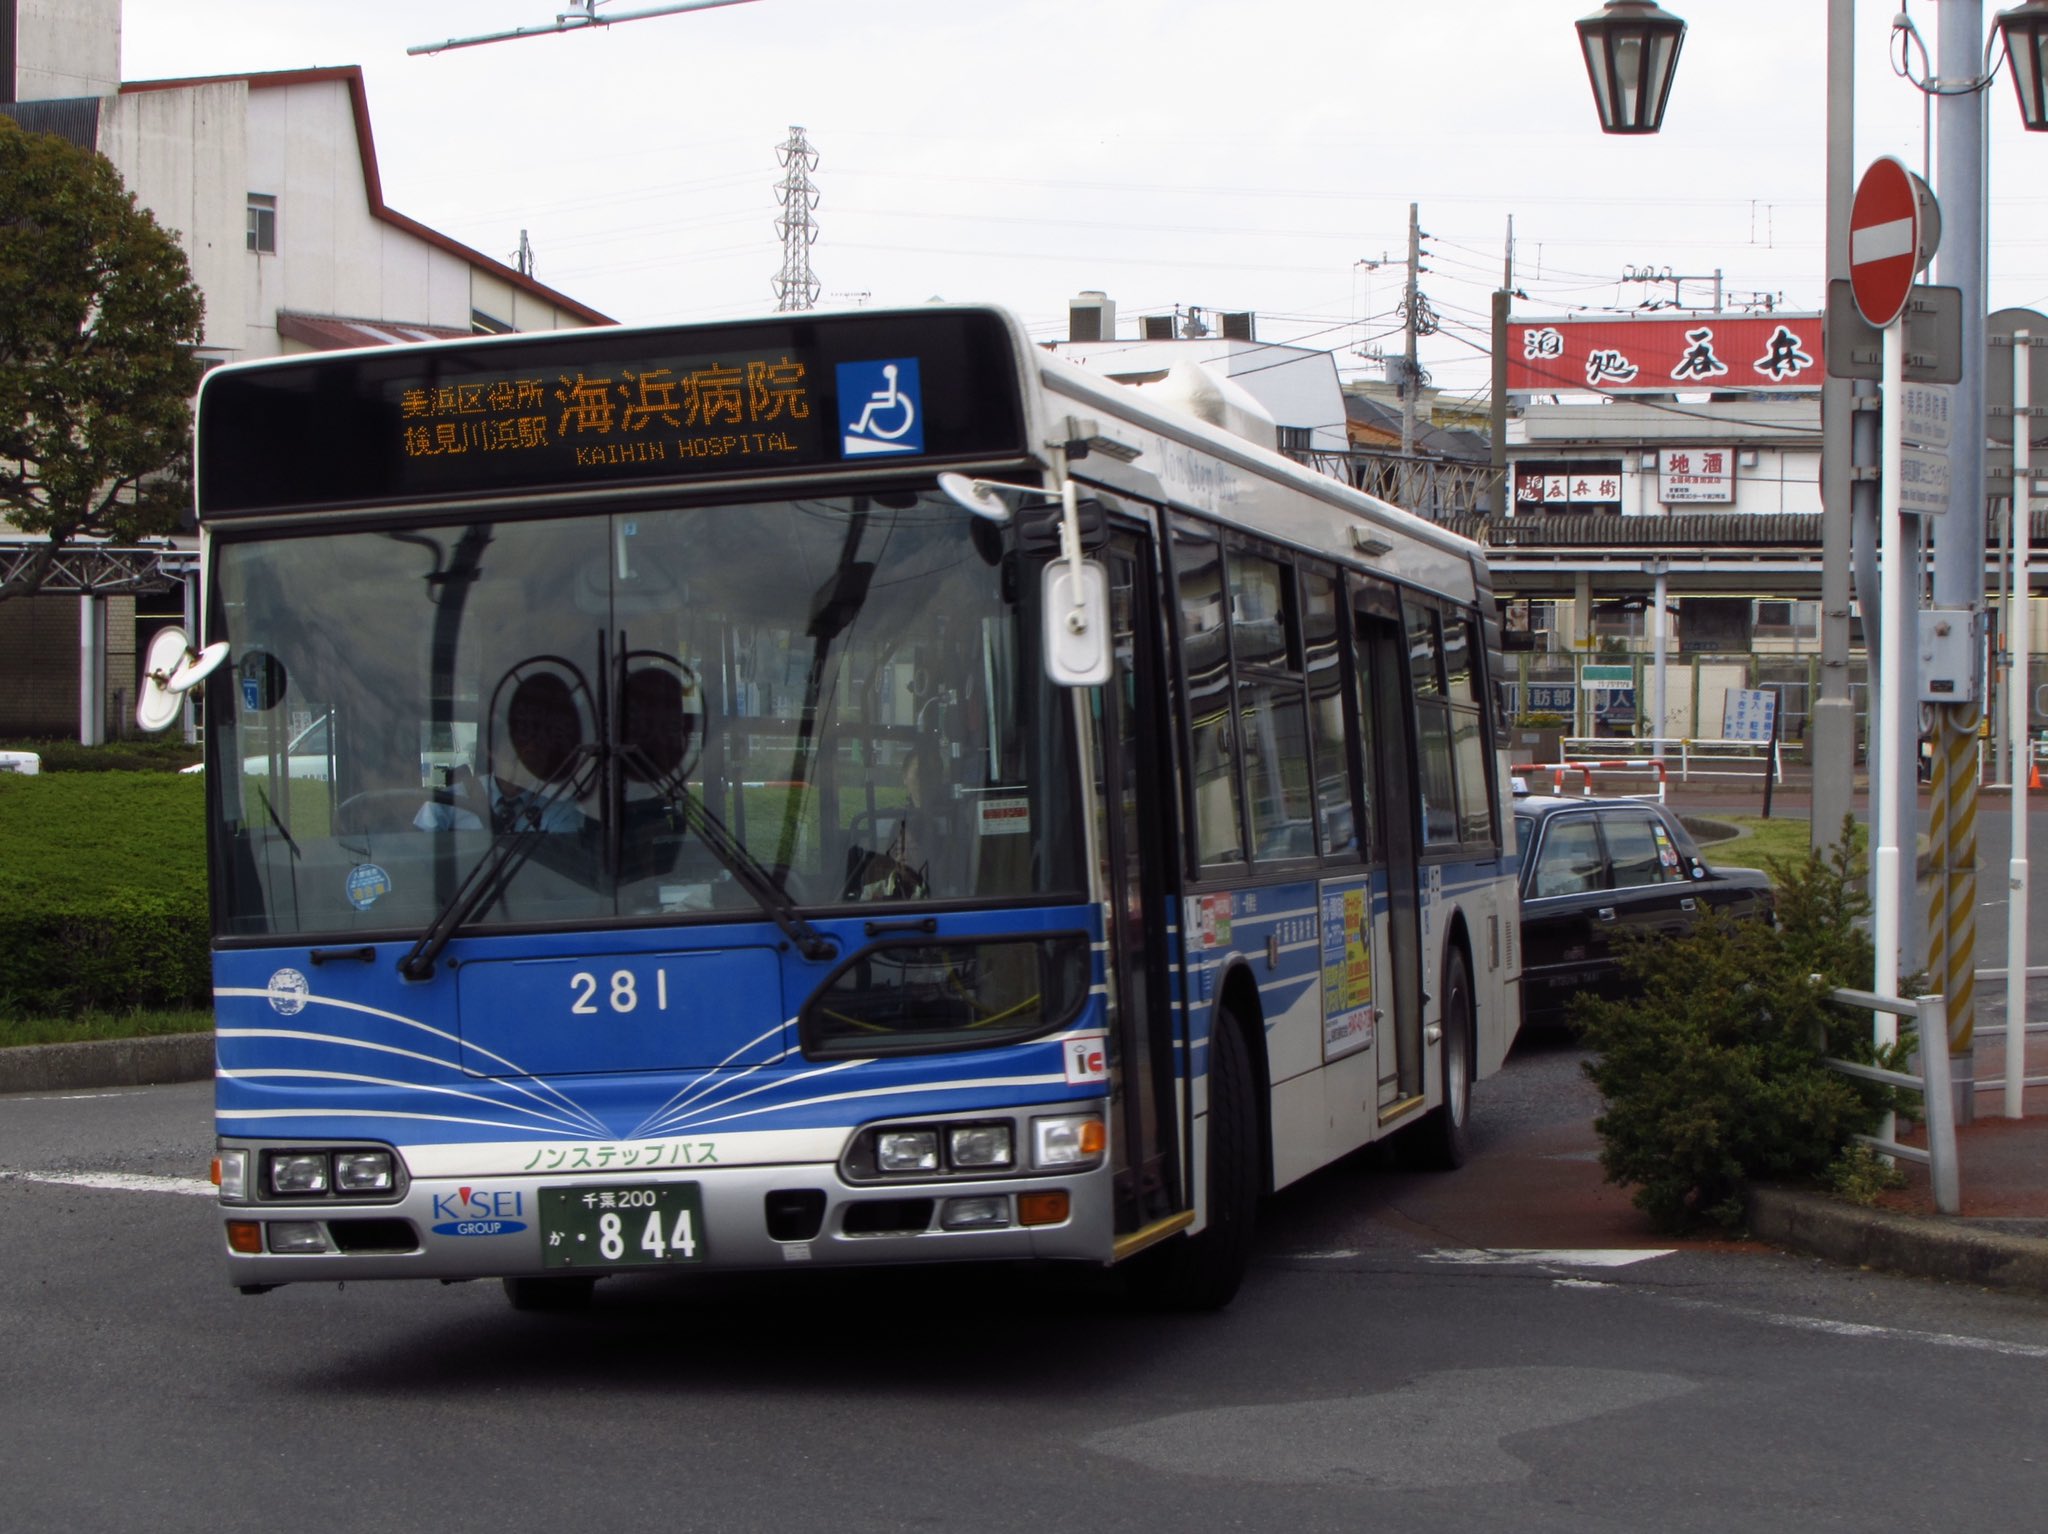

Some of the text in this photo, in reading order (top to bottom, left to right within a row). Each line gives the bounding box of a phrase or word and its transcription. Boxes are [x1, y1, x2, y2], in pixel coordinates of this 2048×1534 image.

[401, 379, 544, 419] 美浜区役所
[555, 357, 809, 436] 海浜病院
[404, 416, 549, 456] 検見川浜駅
[575, 431, 799, 467] KAIHIN HOSPITAL
[1669, 453, 1723, 474] 地酒
[570, 968, 667, 1014] 281
[524, 1142, 718, 1170] ノンステップバス
[582, 1189, 657, 1209] 千葉200
[457, 1221, 502, 1235] GROUP
